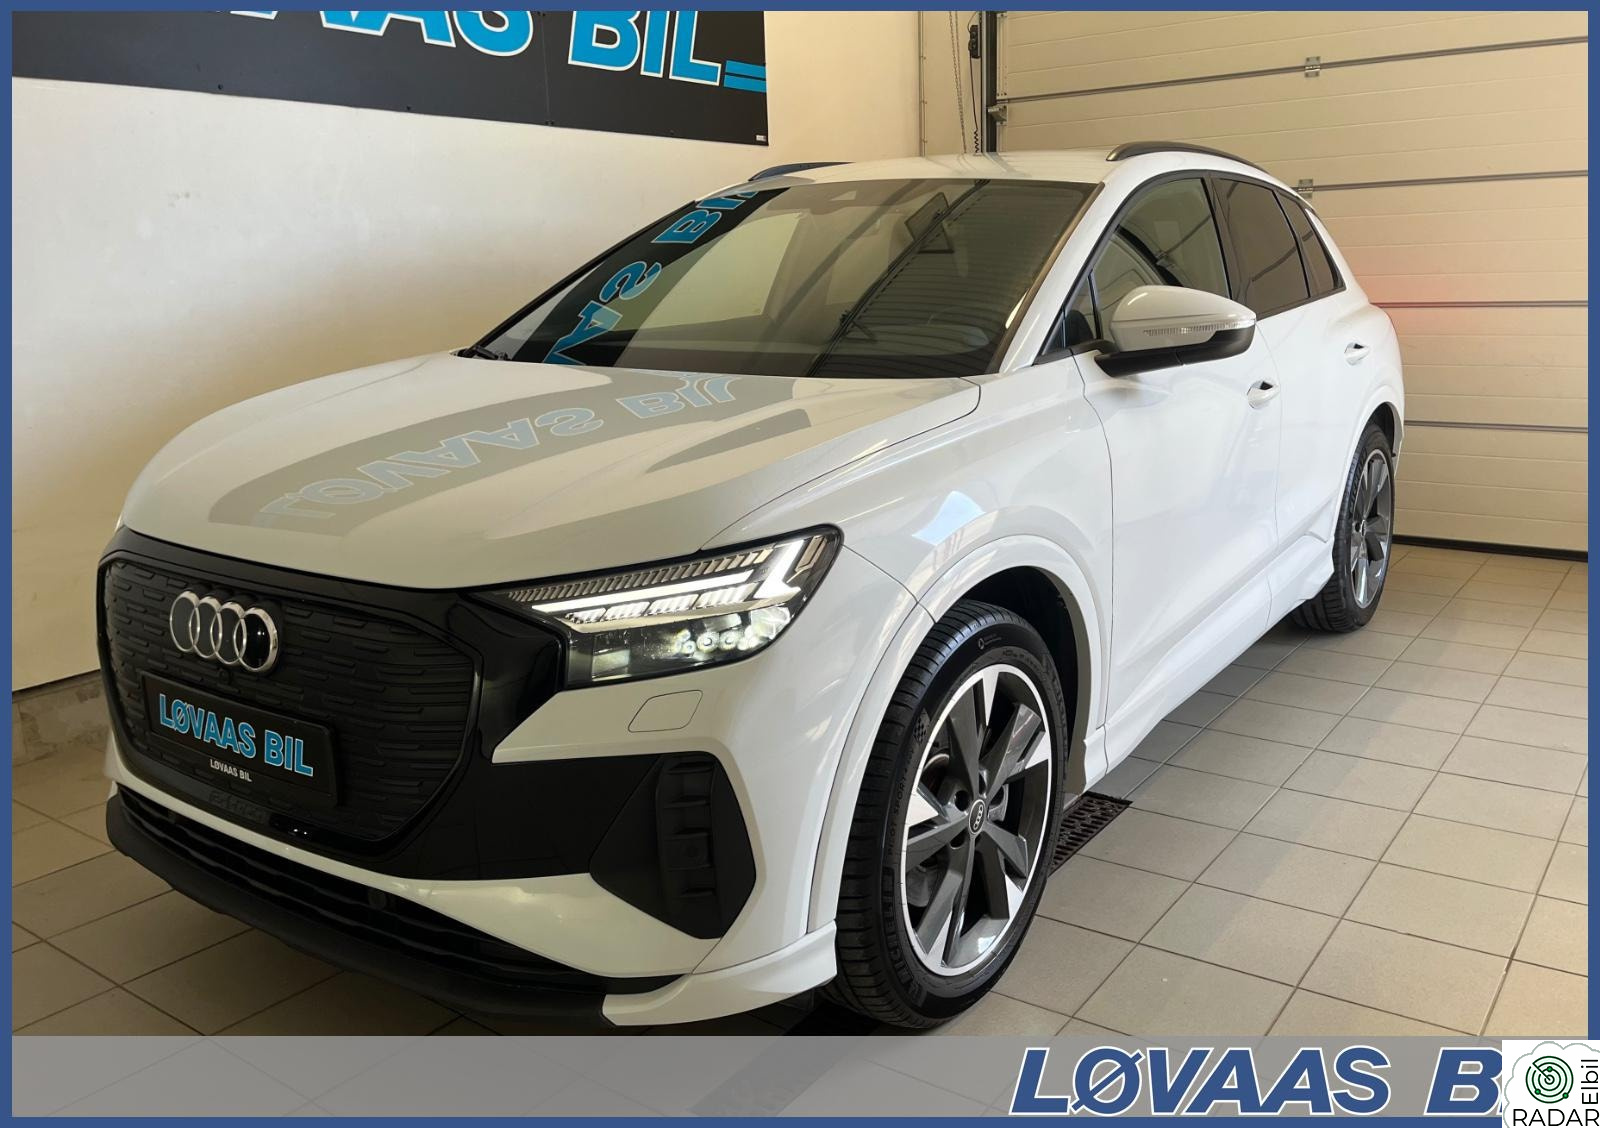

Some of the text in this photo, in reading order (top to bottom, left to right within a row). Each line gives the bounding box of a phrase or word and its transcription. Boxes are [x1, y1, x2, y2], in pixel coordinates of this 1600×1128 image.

[568, 11, 722, 86] BIL
[159, 693, 313, 777] LØVAAS BIL
[210, 758, 252, 782] LØVAAS BIL
